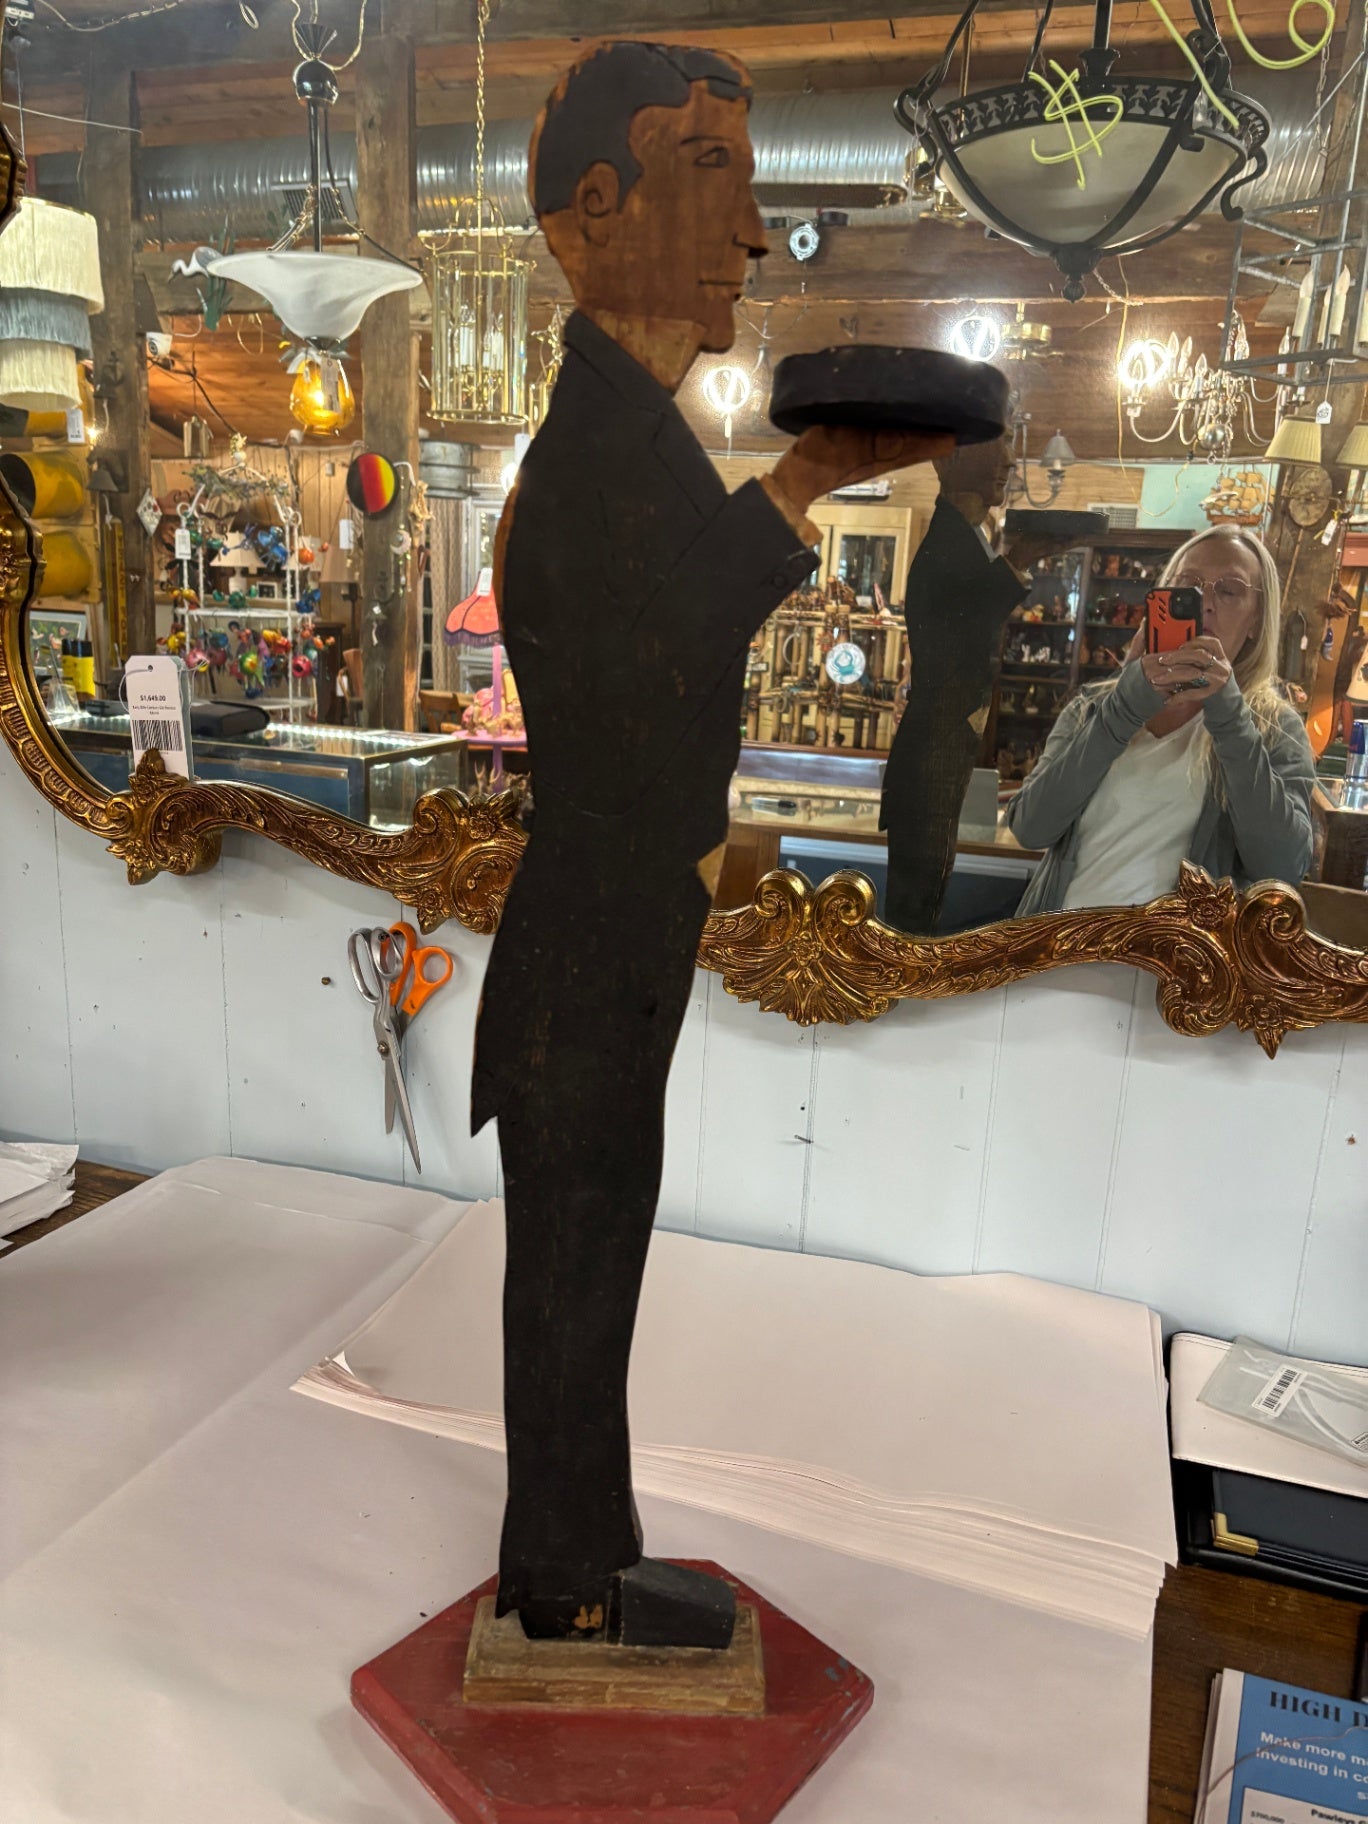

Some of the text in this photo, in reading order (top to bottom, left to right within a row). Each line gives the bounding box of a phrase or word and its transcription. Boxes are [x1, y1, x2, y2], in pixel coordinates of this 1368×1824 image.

[1270, 1691, 1341, 1722] HIGH
[1260, 1732, 1301, 1750] Make
[1305, 1743, 1346, 1761] more
[1256, 1747, 1328, 1776] investing
[1333, 1765, 1348, 1779] in
